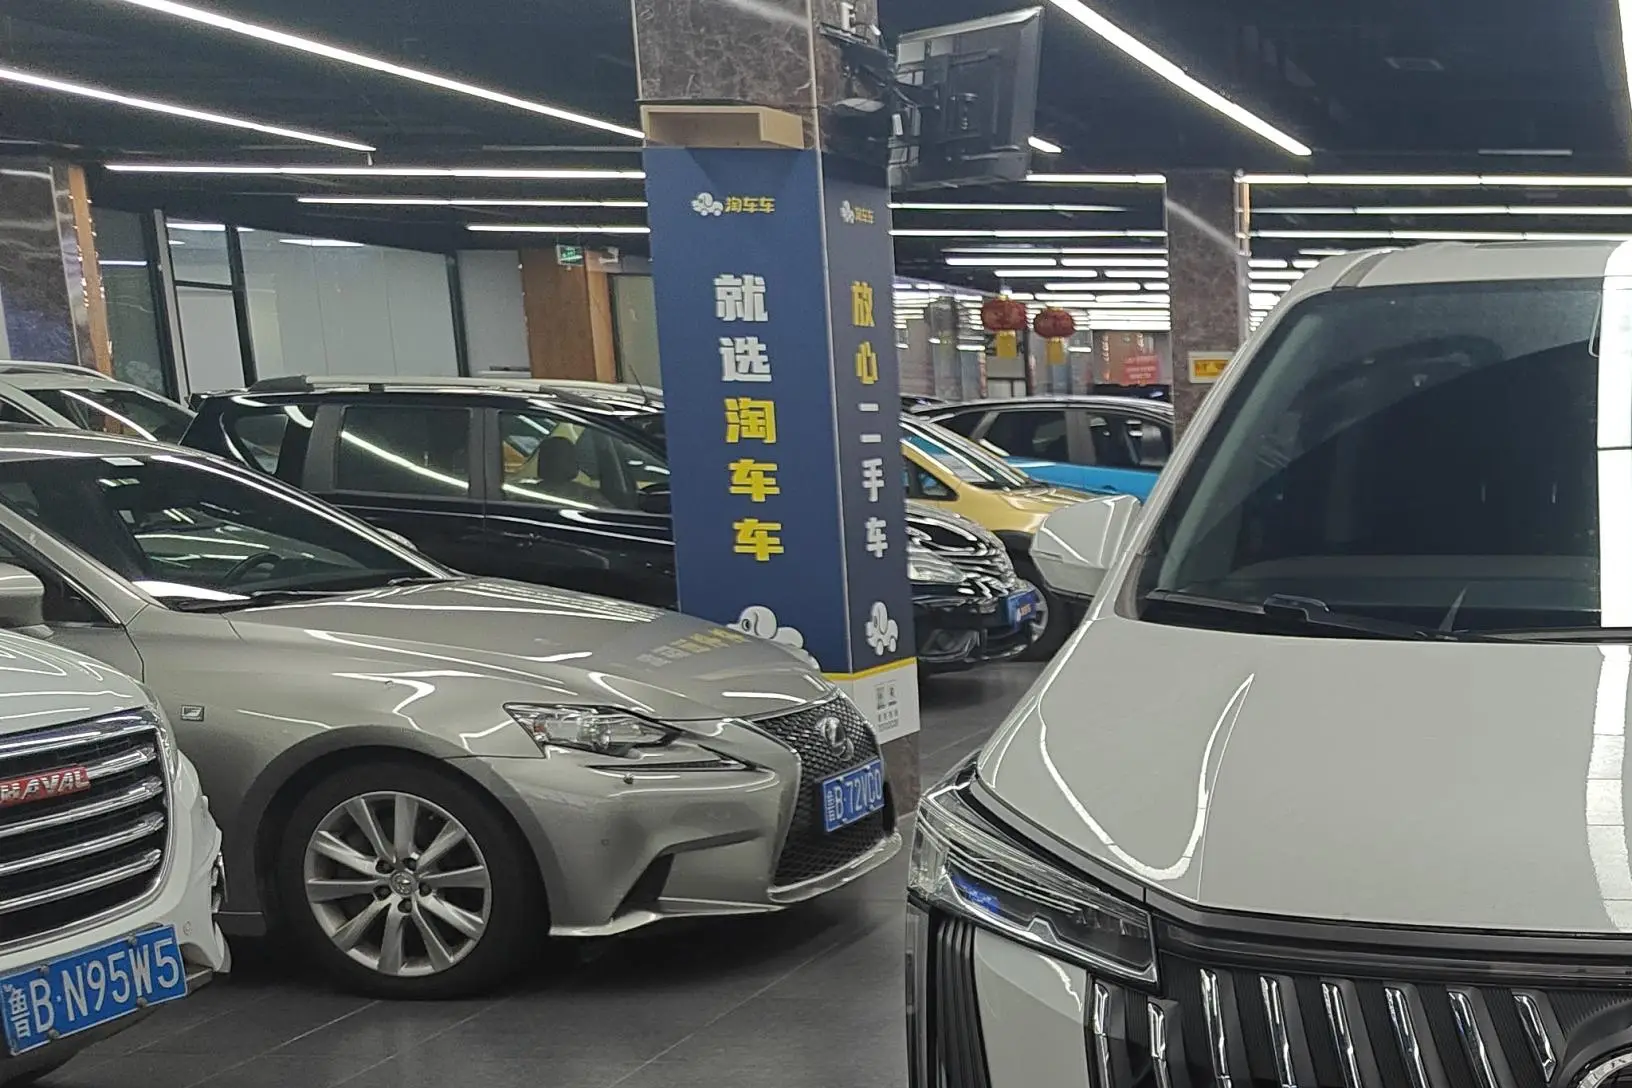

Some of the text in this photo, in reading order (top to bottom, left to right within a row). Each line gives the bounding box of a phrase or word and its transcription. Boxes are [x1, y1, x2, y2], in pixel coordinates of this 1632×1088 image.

[725, 195, 775, 213] 淘车车
[713, 274, 784, 561] 就选淘车车
[851, 280, 888, 558] 放心二手车
